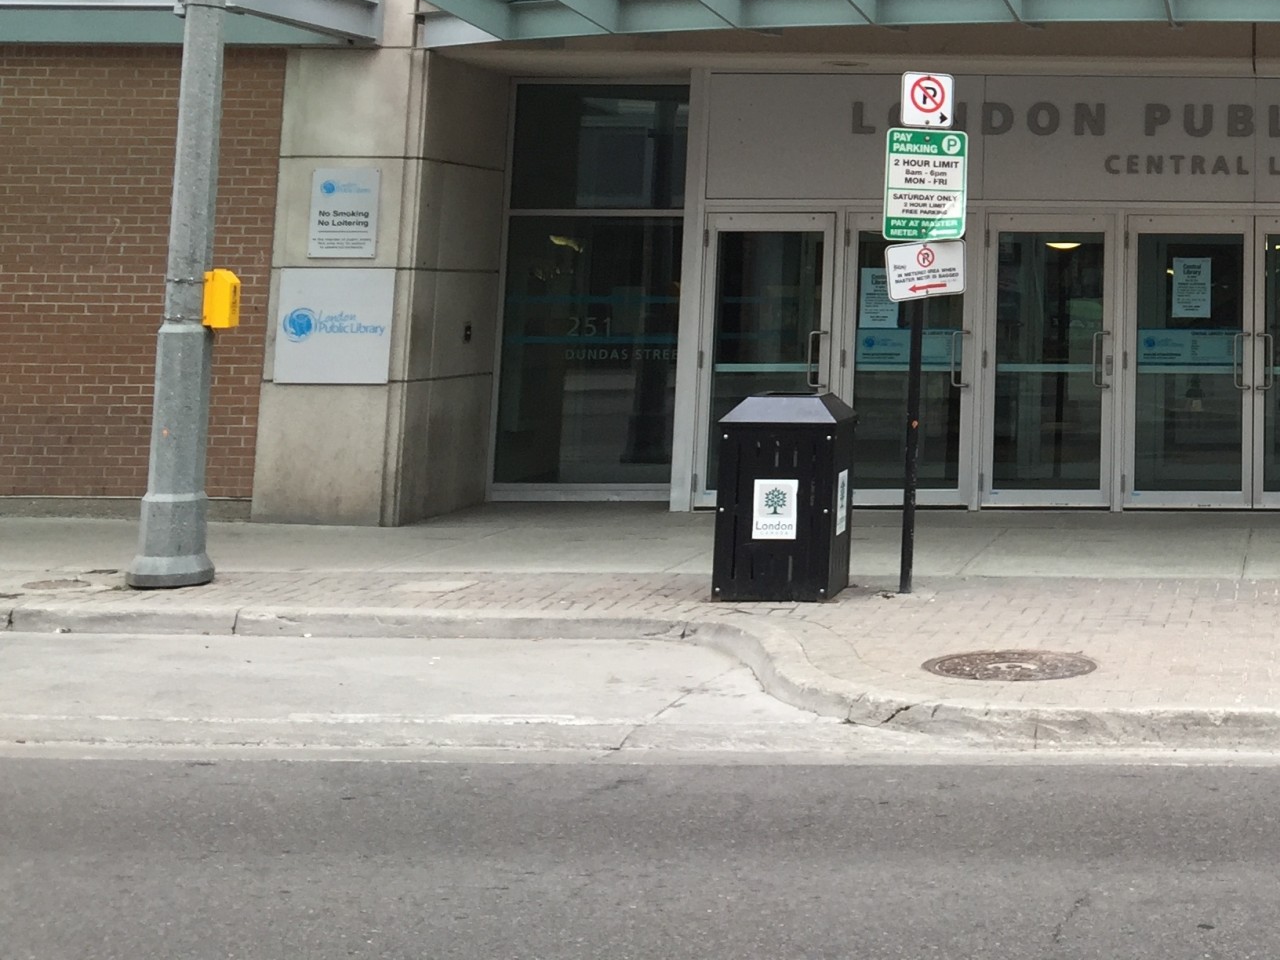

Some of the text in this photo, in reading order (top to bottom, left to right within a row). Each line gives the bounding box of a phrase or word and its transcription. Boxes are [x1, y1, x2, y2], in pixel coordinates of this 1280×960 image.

[893, 132, 913, 142] PAY
[893, 143, 938, 154] PARKING
[903, 159, 930, 167] HOUR
[933, 160, 959, 168] LIMIT
[1105, 154, 1250, 176] CENTRAL
[893, 193, 934, 201] SATURDAY
[333, 210, 369, 218] Smoking
[332, 219, 369, 227] Loitering
[890, 228, 918, 236] METER
[318, 310, 357, 322] London
[319, 322, 386, 336] Public Library
[567, 316, 613, 337] 251
[566, 348, 678, 360] DUNDAS STREE
[755, 521, 793, 530] London
